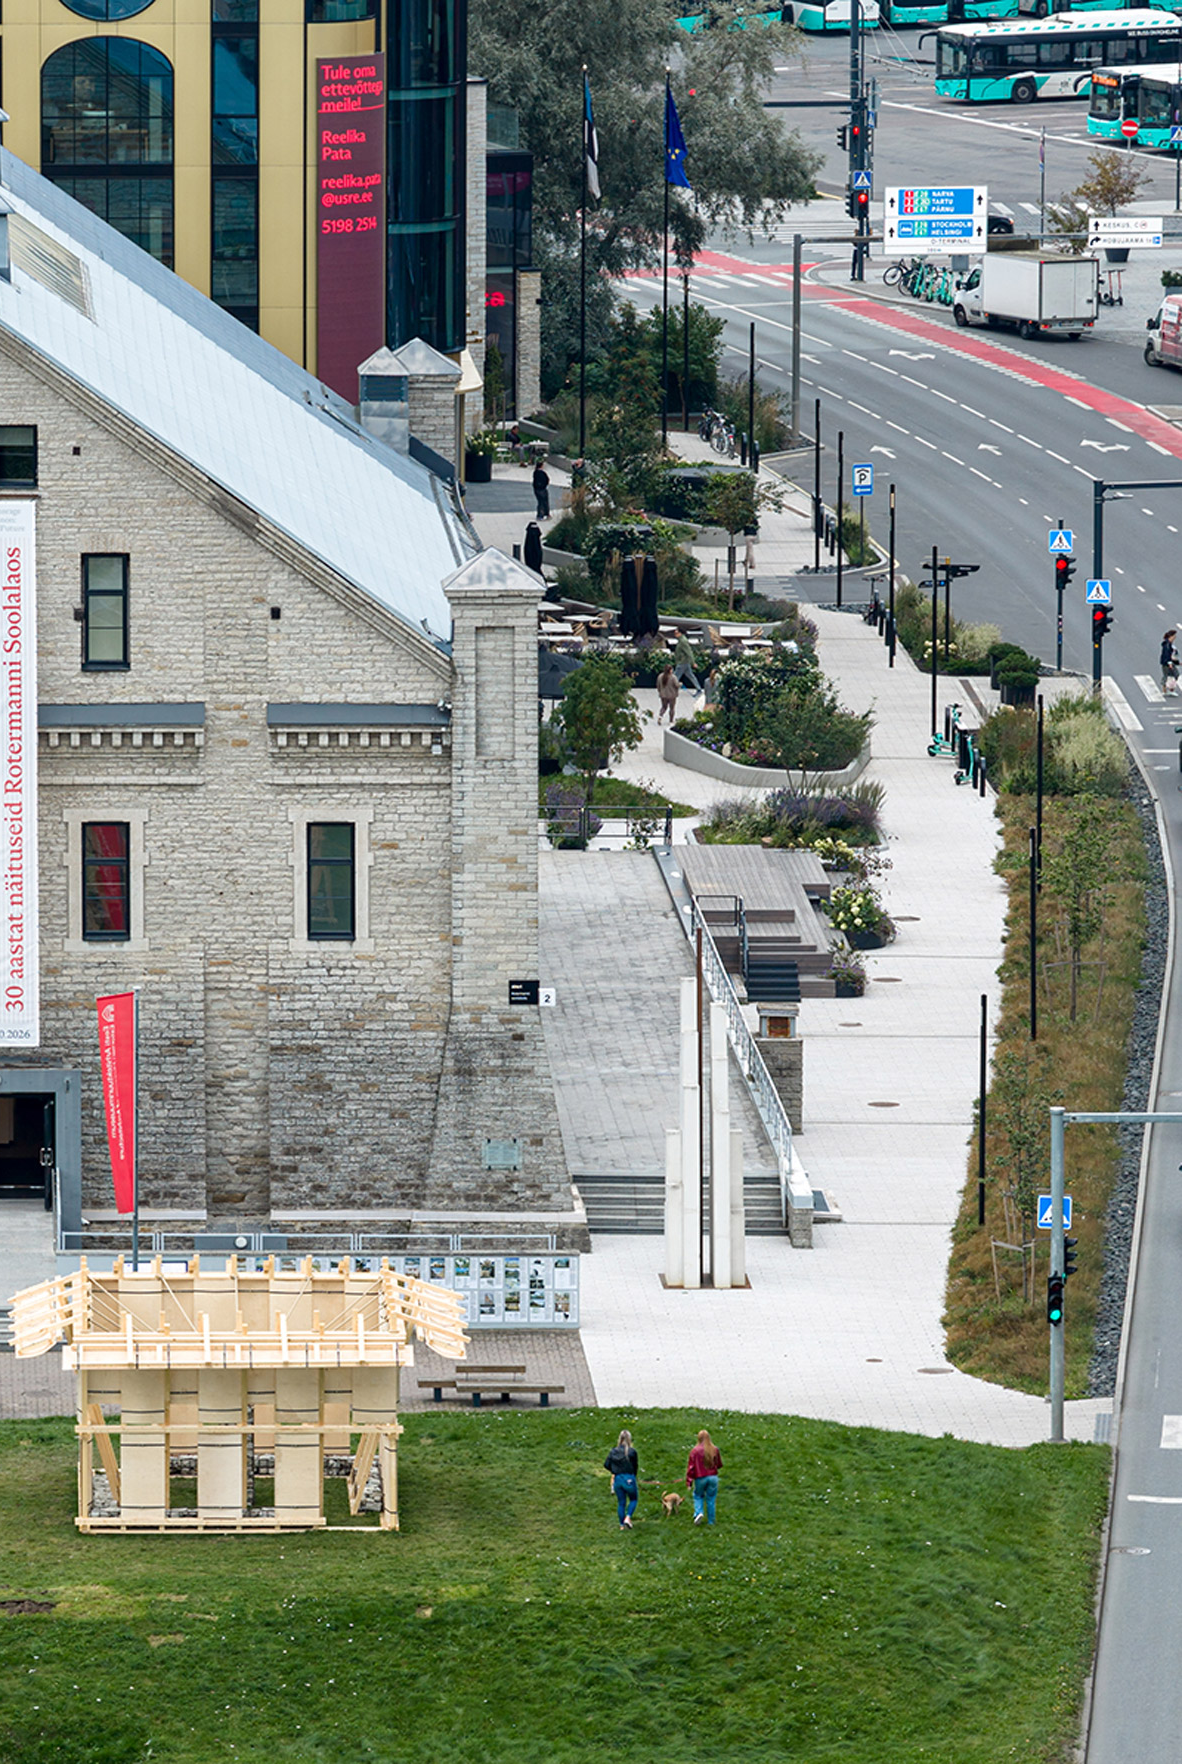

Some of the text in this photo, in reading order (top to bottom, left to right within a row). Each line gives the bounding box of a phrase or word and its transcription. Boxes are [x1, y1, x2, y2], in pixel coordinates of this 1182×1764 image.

[321, 65, 376, 80] Tule oma
[322, 97, 362, 111] meile!
[322, 129, 366, 144] Reelika
[322, 147, 352, 160] Pata
[322, 174, 381, 189] reelika.pata
[322, 192, 373, 207] @usre.ee
[322, 216, 377, 234] 5198 2514
[1, 547, 24, 1011] 30 aastat näituseid Rotermanni Soolalaos
[544, 993, 551, 1003] 2
